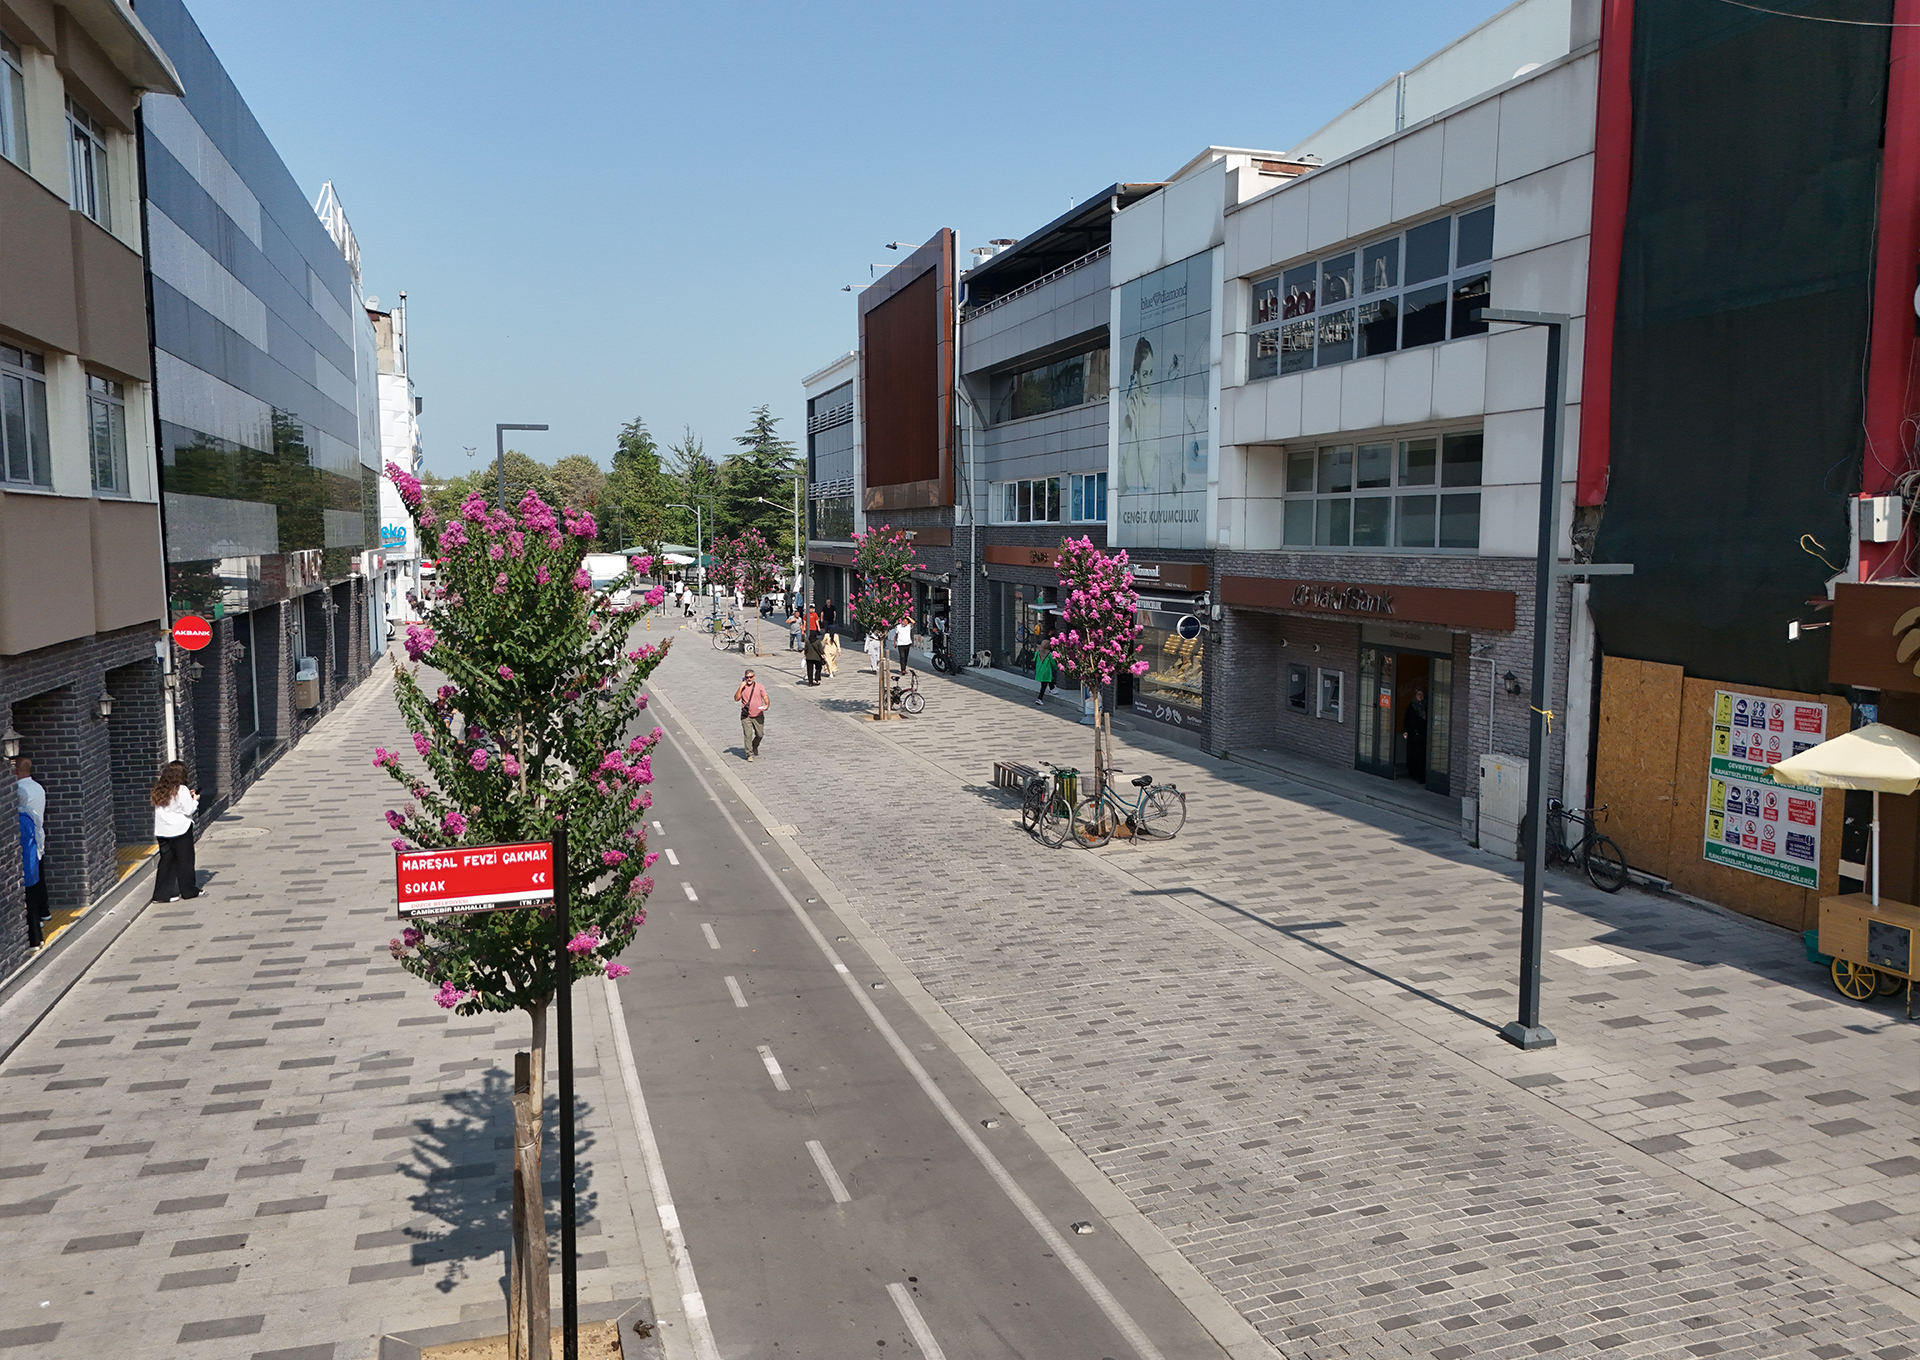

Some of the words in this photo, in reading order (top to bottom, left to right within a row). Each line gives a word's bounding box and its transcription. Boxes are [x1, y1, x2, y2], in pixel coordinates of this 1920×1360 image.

[1123, 507, 1147, 524] CENGİZ
[1148, 509, 1199, 524] KUYUMCULUK
[381, 523, 406, 539] eko
[402, 857, 458, 871] MAREŞAL
[463, 851, 497, 867] FEVZİ
[502, 849, 547, 865] ÇAKMAK
[405, 880, 446, 894] SOKAK
[410, 906, 452, 916] CAMİKEBİR
